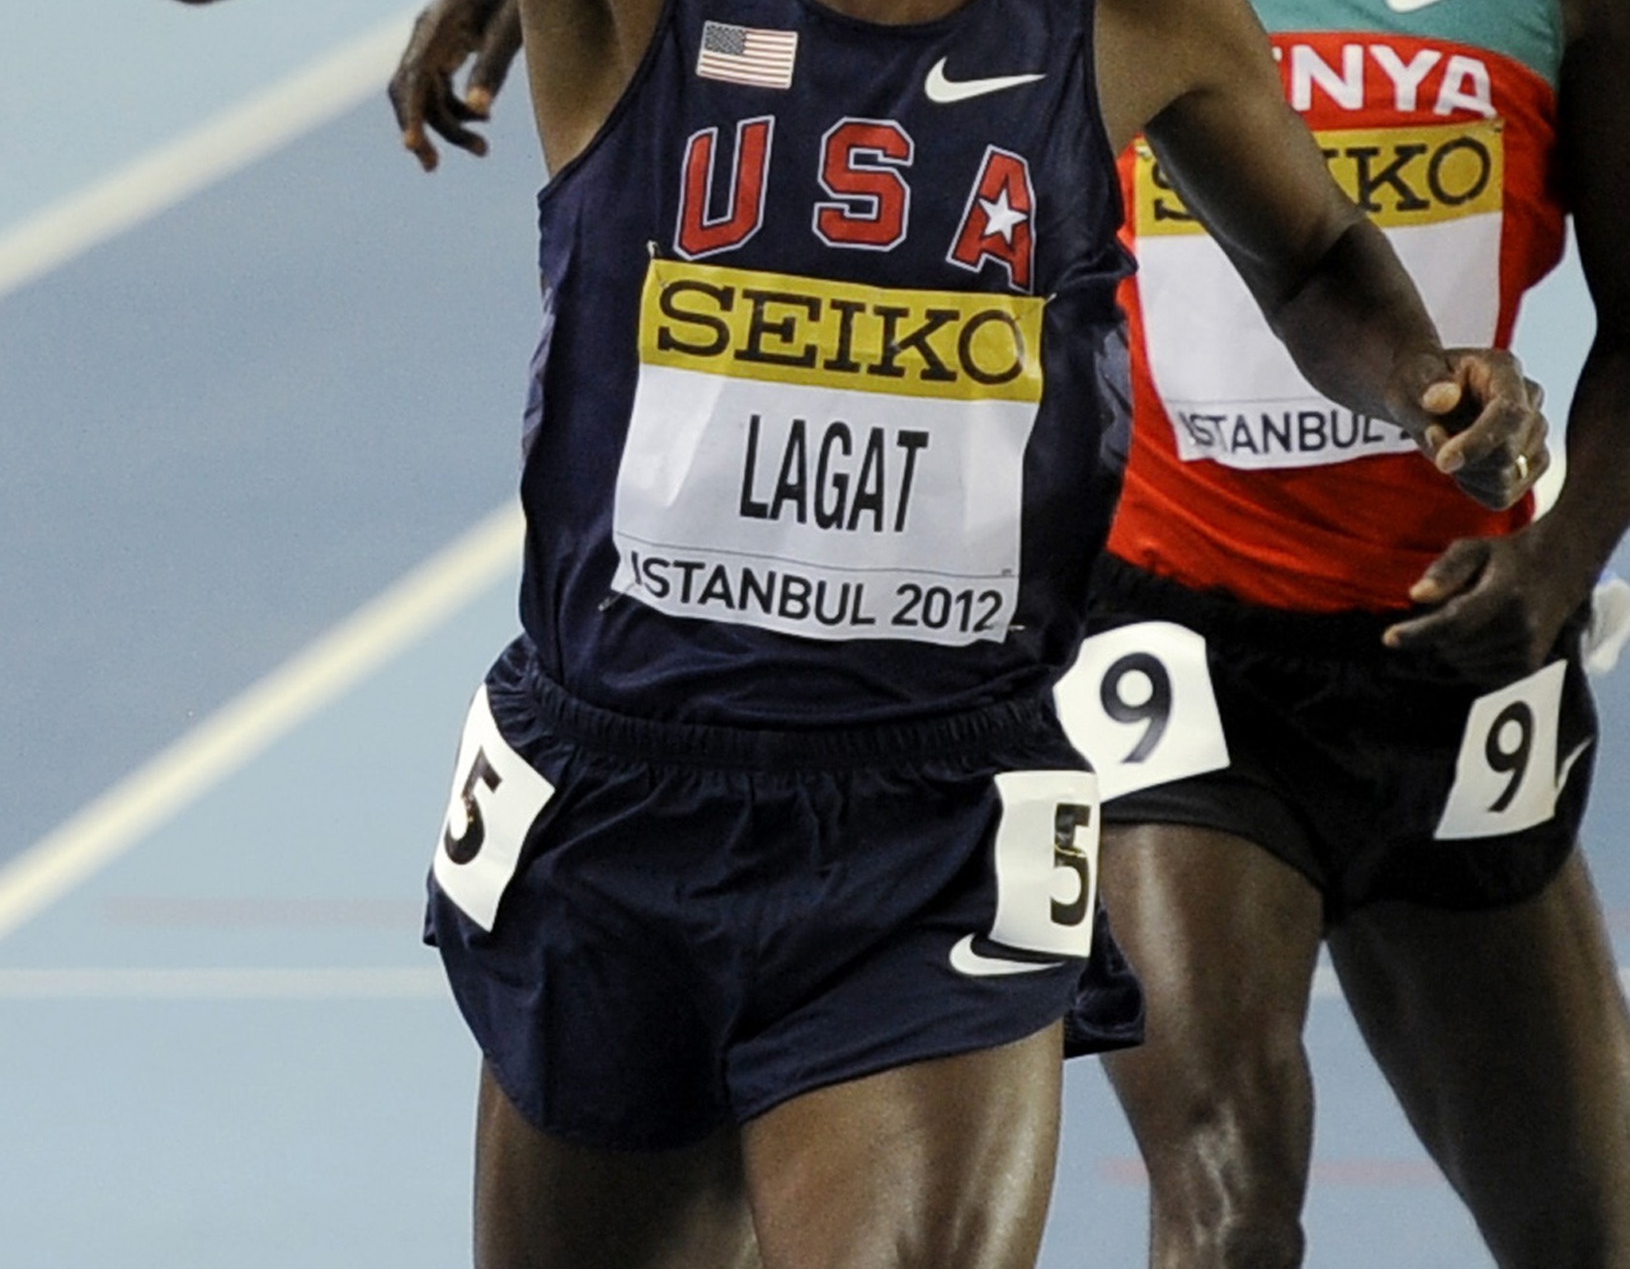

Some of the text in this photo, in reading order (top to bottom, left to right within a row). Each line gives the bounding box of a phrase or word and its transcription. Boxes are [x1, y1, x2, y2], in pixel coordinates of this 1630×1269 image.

[1273, 44, 1498, 119] NYA
[674, 115, 1036, 294] USA
[657, 279, 1027, 386] SEIKO
[739, 414, 930, 533] LAGAT
[1179, 410, 1385, 454] ISTANBUL
[631, 550, 1004, 633] ISTANBUL 2012
[1100, 651, 1173, 765] 9
[1484, 700, 1535, 814] 9
[444, 744, 503, 866] 5
[1050, 802, 1092, 928] 5
